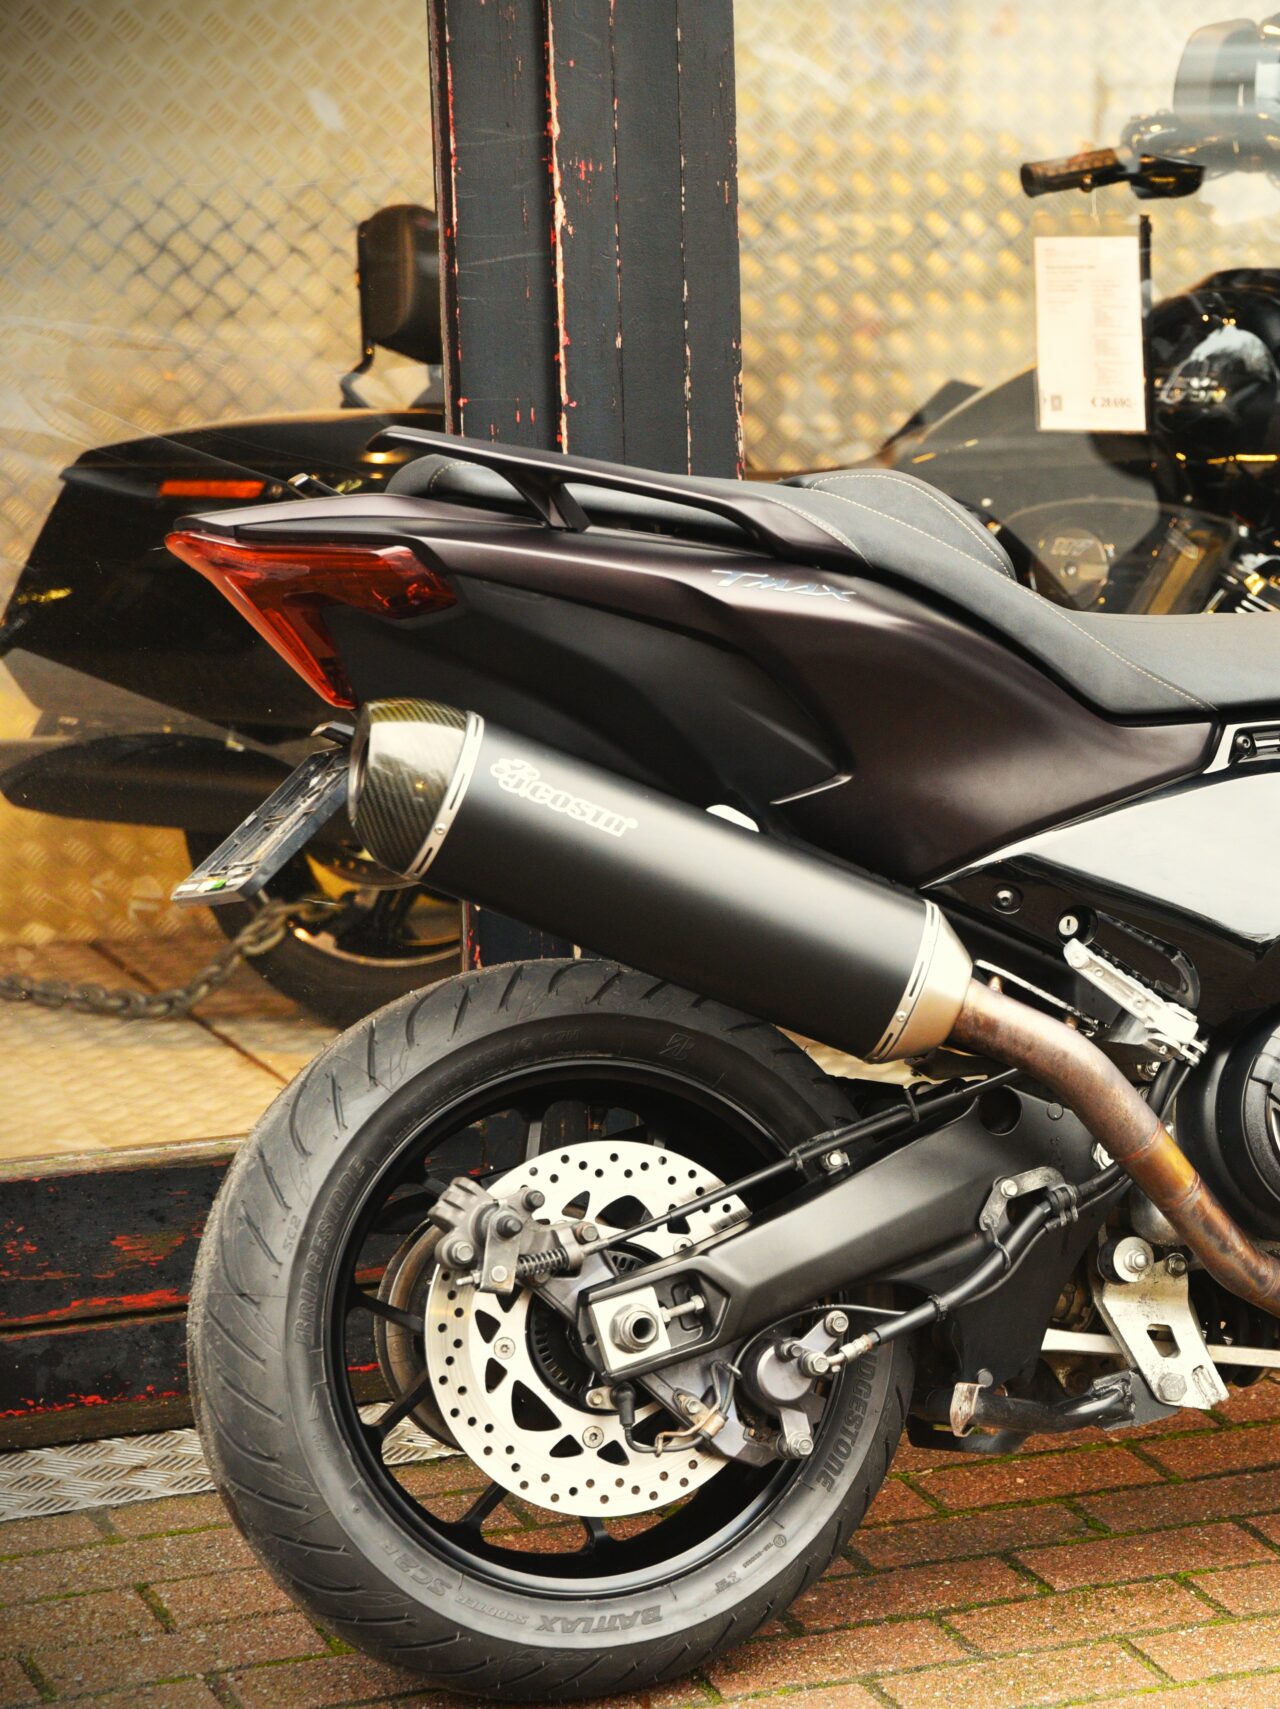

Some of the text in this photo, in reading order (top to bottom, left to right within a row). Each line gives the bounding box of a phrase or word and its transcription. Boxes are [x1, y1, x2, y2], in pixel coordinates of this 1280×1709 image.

[711, 569, 857, 603] TMAX
[294, 1154, 366, 1347] BRIDGESTONE
[815, 1345, 881, 1493] IDGESTONE
[535, 1604, 664, 1634] BATTLAX
